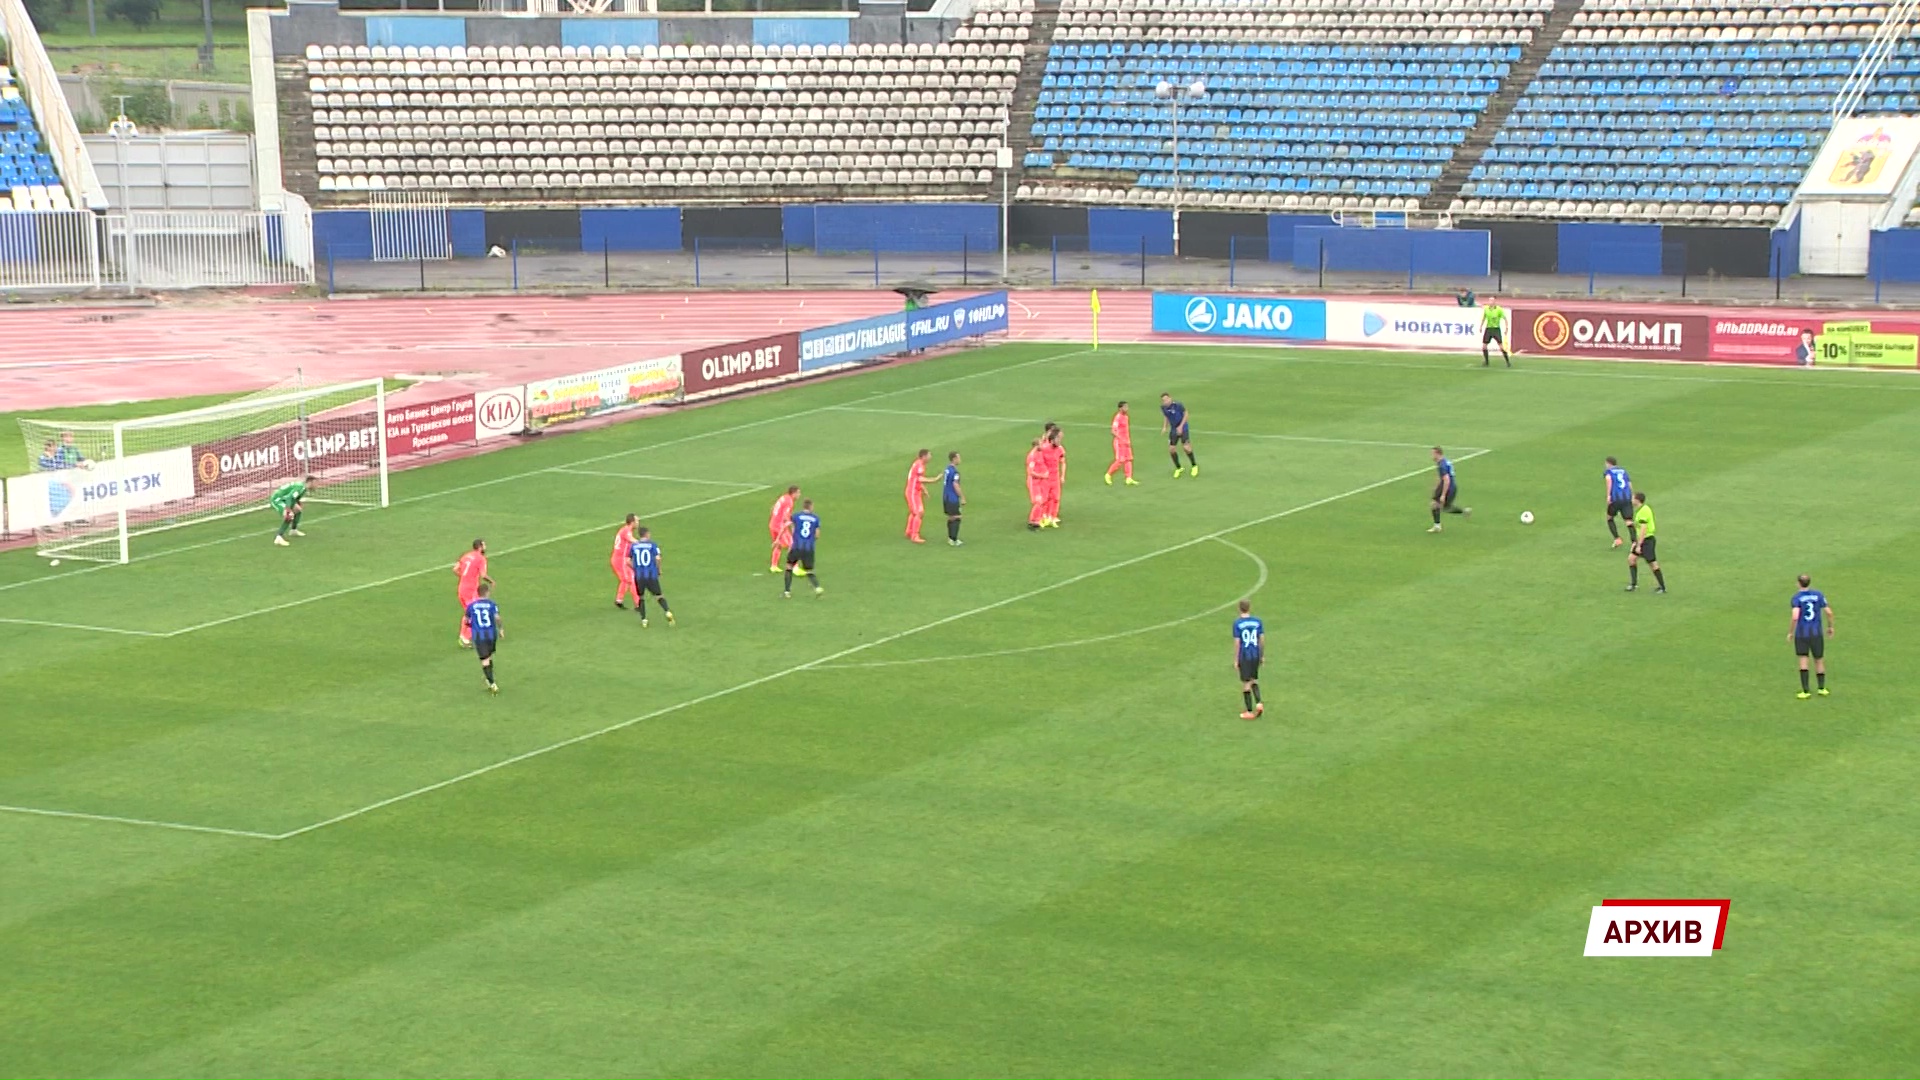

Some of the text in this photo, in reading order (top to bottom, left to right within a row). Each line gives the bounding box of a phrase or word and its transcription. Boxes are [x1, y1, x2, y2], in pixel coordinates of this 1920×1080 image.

[911, 315, 949, 336] 1FNL.RU
[1222, 303, 1293, 330] JAKO
[1394, 320, 1475, 335] НОВАТЭК
[1573, 319, 1682, 344] ОЛИМП
[702, 345, 782, 381] OLIMP.BET
[487, 401, 514, 423] KIA
[293, 427, 378, 460] OLIMP.BET
[220, 445, 280, 472] ОЛИМП
[801, 521, 811, 538] 8
[635, 549, 651, 566] 10
[474, 609, 491, 627] 13
[1804, 602, 1815, 621] 3
[1242, 629, 1258, 647] 94
